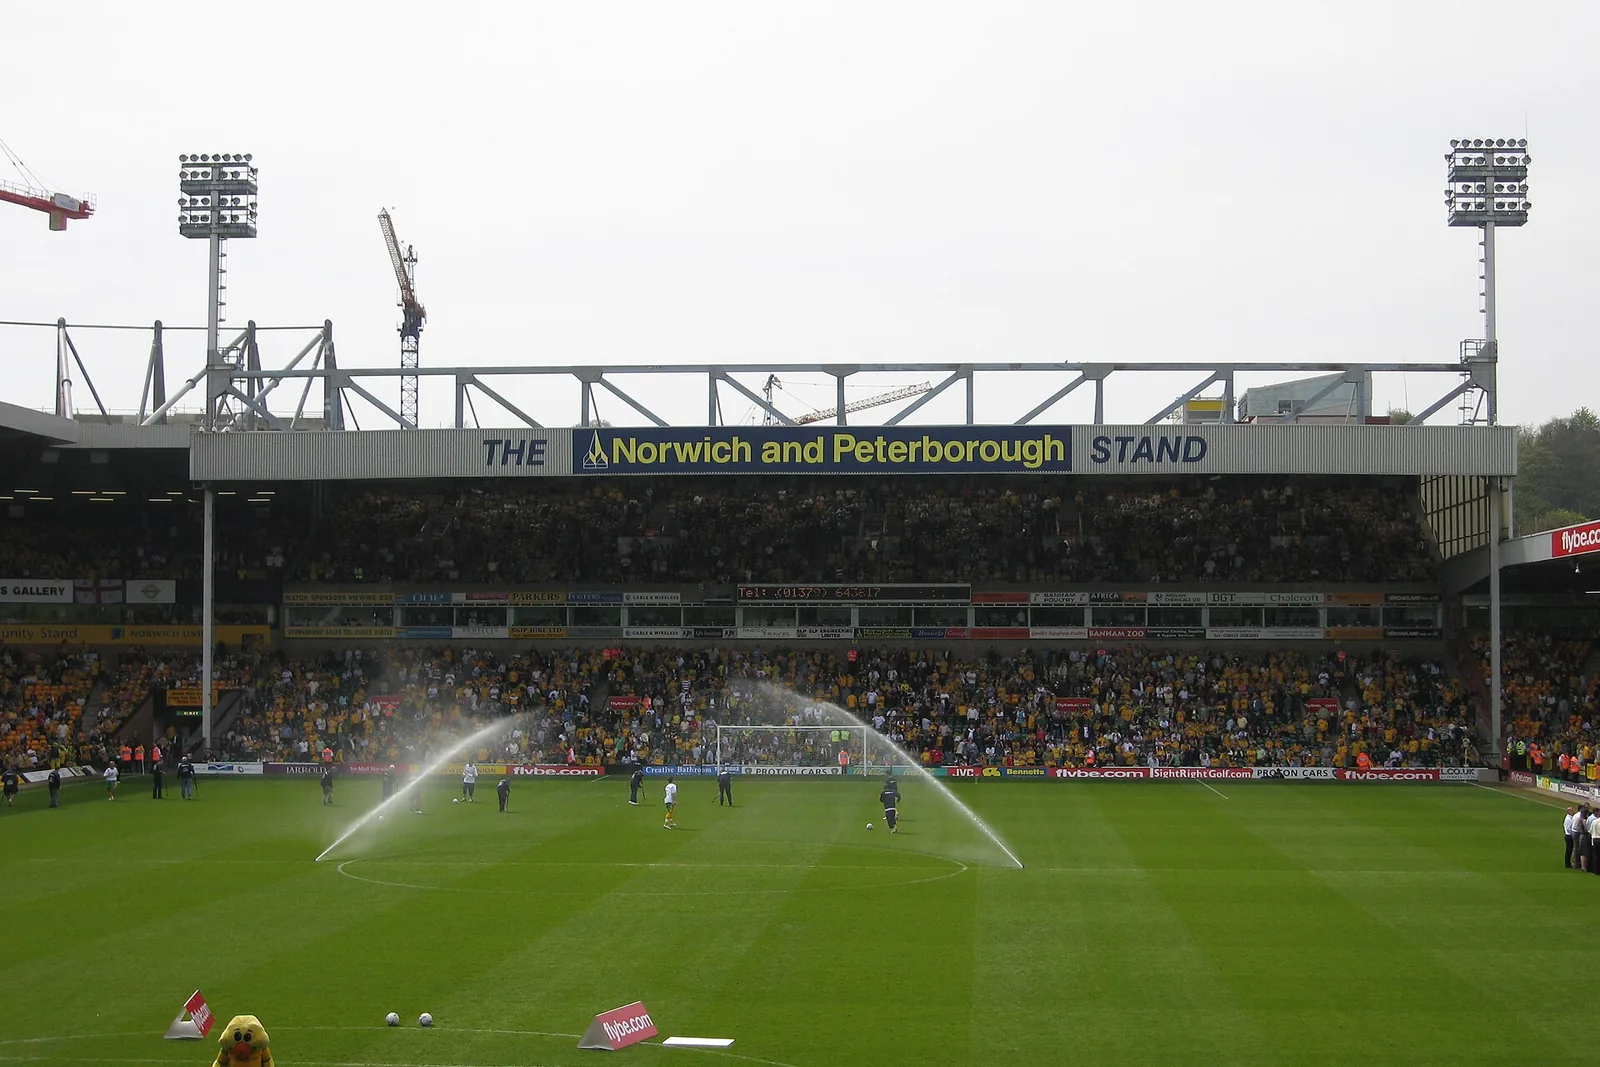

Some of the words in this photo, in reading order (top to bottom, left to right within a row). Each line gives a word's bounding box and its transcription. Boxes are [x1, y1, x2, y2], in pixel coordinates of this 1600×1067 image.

[484, 439, 546, 467] THE
[613, 436, 751, 464] Norwich
[761, 436, 824, 464] and
[833, 434, 1064, 469] Peterborough
[1090, 436, 1208, 464] STAND
[13, 587, 66, 596] GALLERY
[739, 587, 766, 598] Tel:
[513, 593, 560, 601] PARKERS
[1212, 593, 1236, 602] DGT
[1270, 593, 1319, 602] Chalcroft
[0, 628, 34, 640] unity
[40, 627, 77, 639] Stand
[131, 629, 180, 637] NORWICH
[183, 629, 204, 637] UNI
[286, 766, 327, 774] JARROLD
[513, 766, 599, 775] flybe.com
[952, 768, 974, 777] JVC
[1056, 768, 1144, 778] flybe.com
[1154, 769, 1251, 779] SightRightGolf.com
[1302, 769, 1328, 777] CARS
[1344, 770, 1433, 780] flybe.com
[603, 1012, 654, 1042] flybe.com
